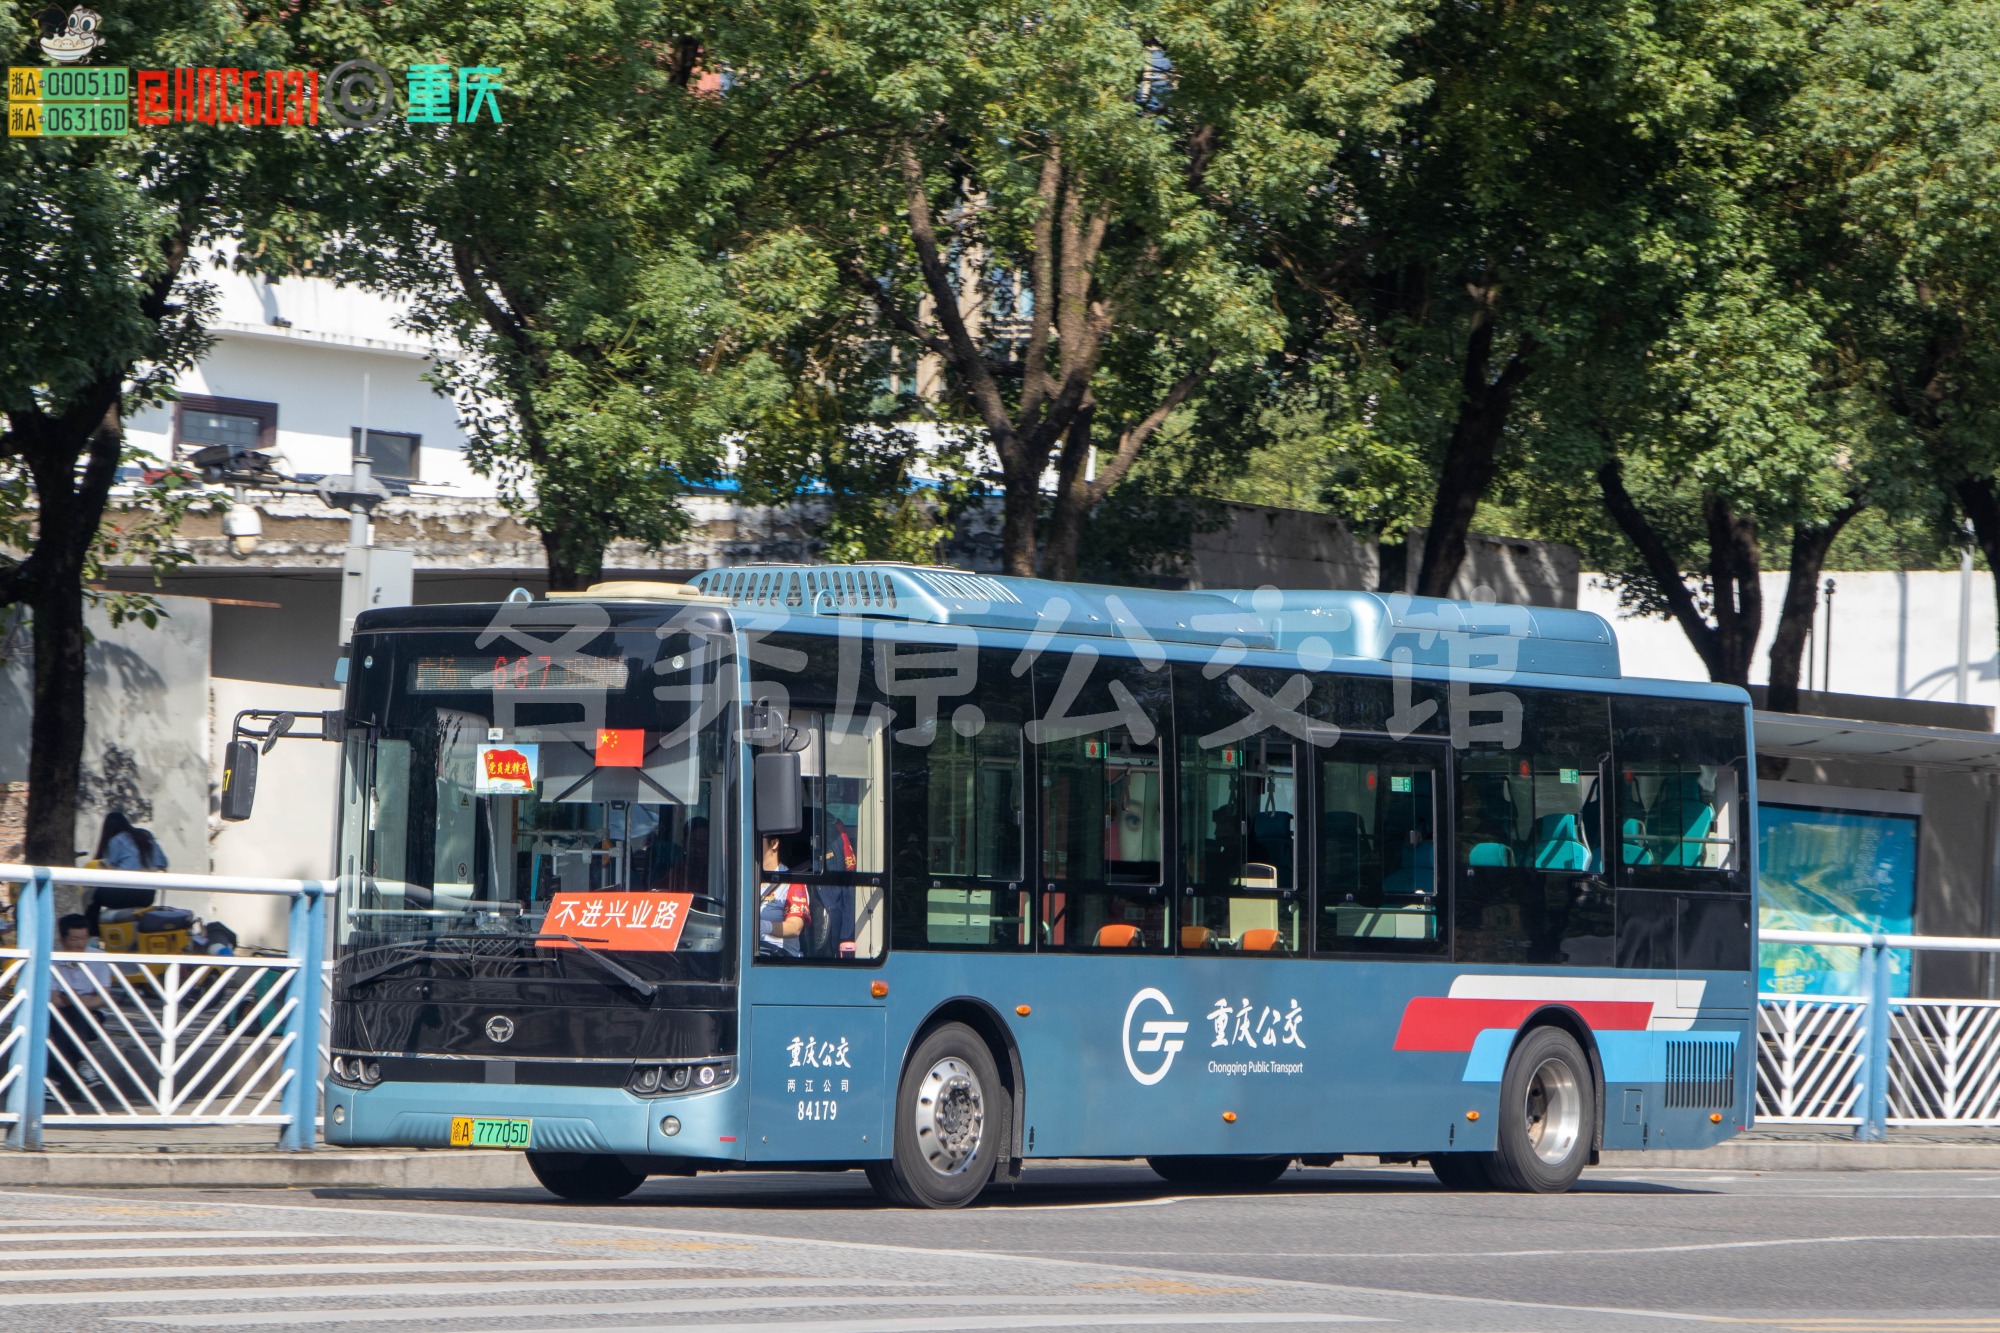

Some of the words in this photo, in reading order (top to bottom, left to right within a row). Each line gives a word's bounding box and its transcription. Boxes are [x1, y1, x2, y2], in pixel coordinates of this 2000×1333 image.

[493, 656, 552, 690] 667
[488, 761, 528, 775] 党员先锋号
[554, 899, 680, 929] 不进兴业路
[1206, 998, 1307, 1049] 重庆公交
[786, 1036, 852, 1069] 重庆公交
[1207, 1060, 1247, 1076] Chongqing
[1248, 1061, 1270, 1073] Public
[1270, 1061, 1303, 1076] Transport
[787, 1079, 850, 1093] 两江公司
[797, 1100, 838, 1121] 84179
